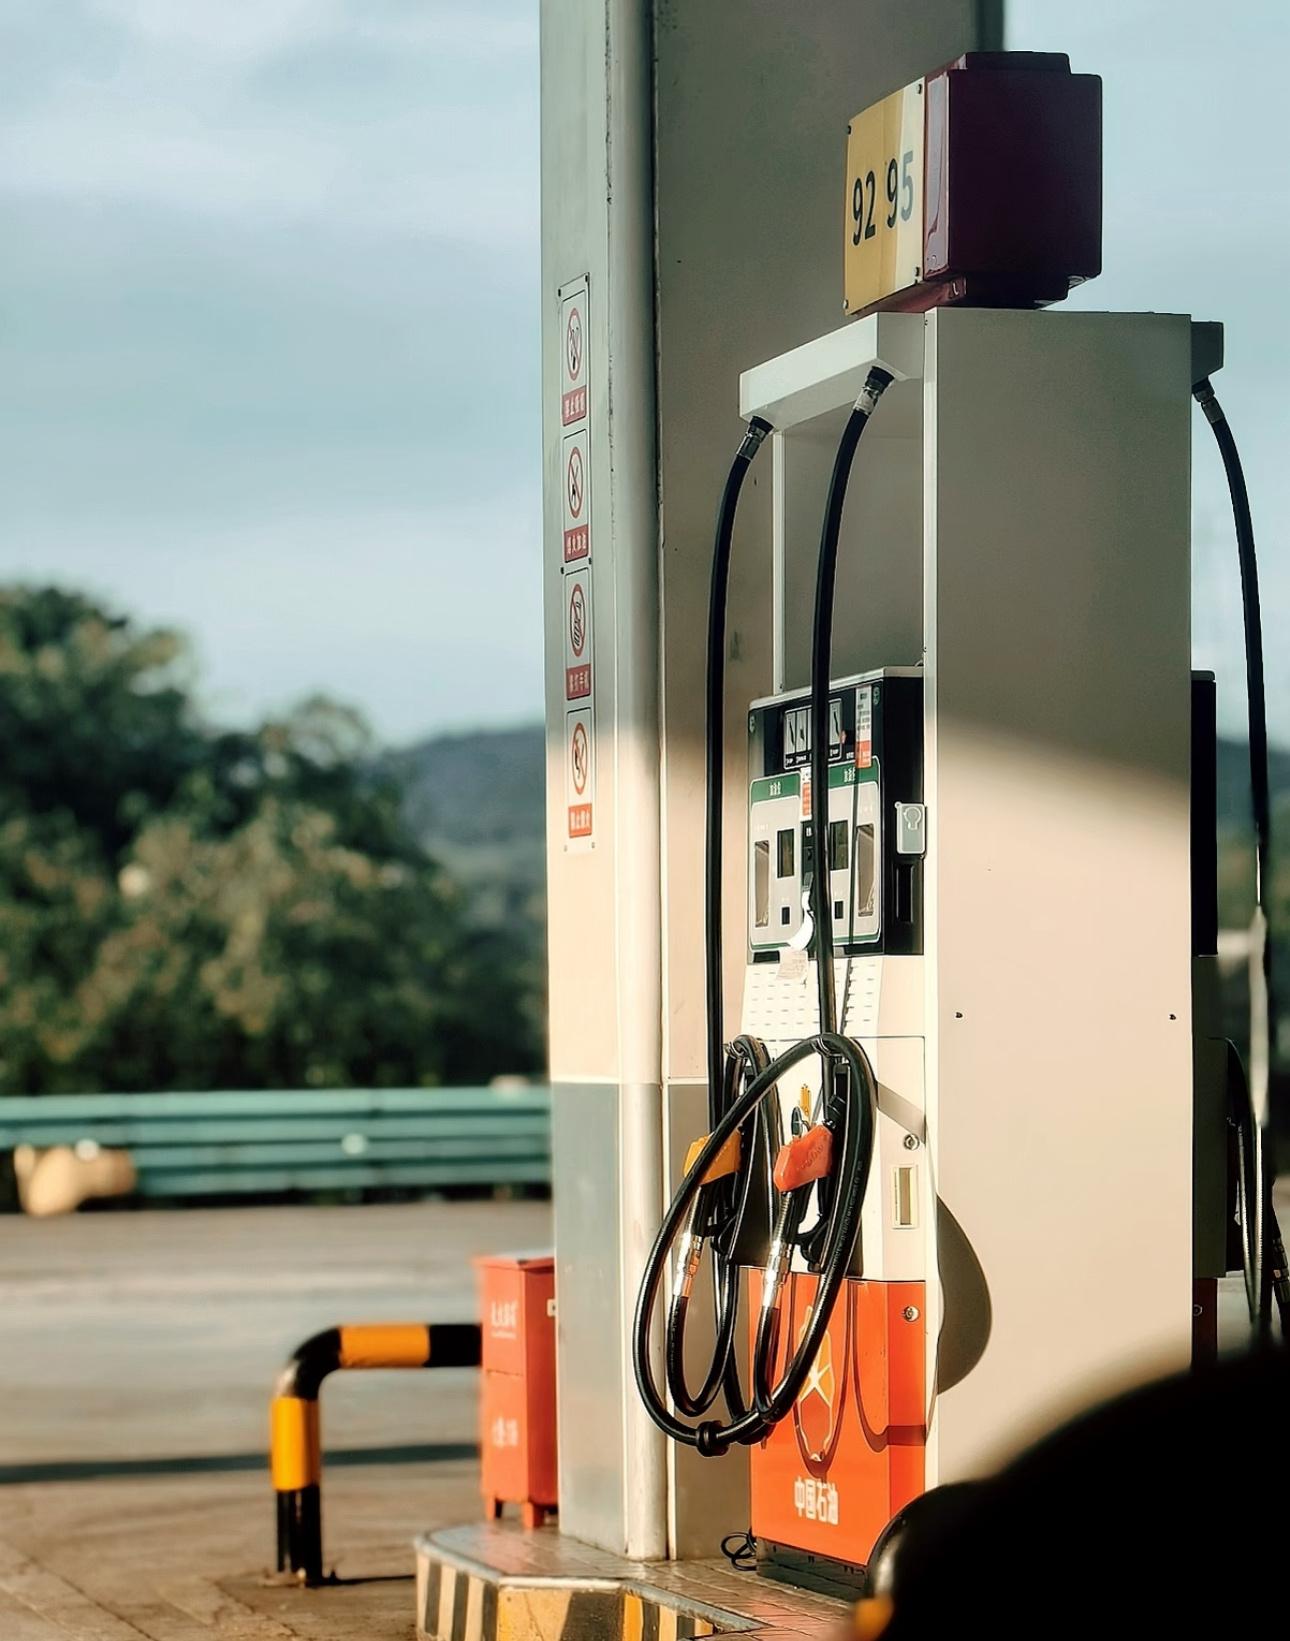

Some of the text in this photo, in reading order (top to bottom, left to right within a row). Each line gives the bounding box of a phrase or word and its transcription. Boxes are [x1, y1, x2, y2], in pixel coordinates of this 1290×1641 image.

[853, 150, 914, 246] 92 95
[794, 1476, 839, 1525] 中国石油
